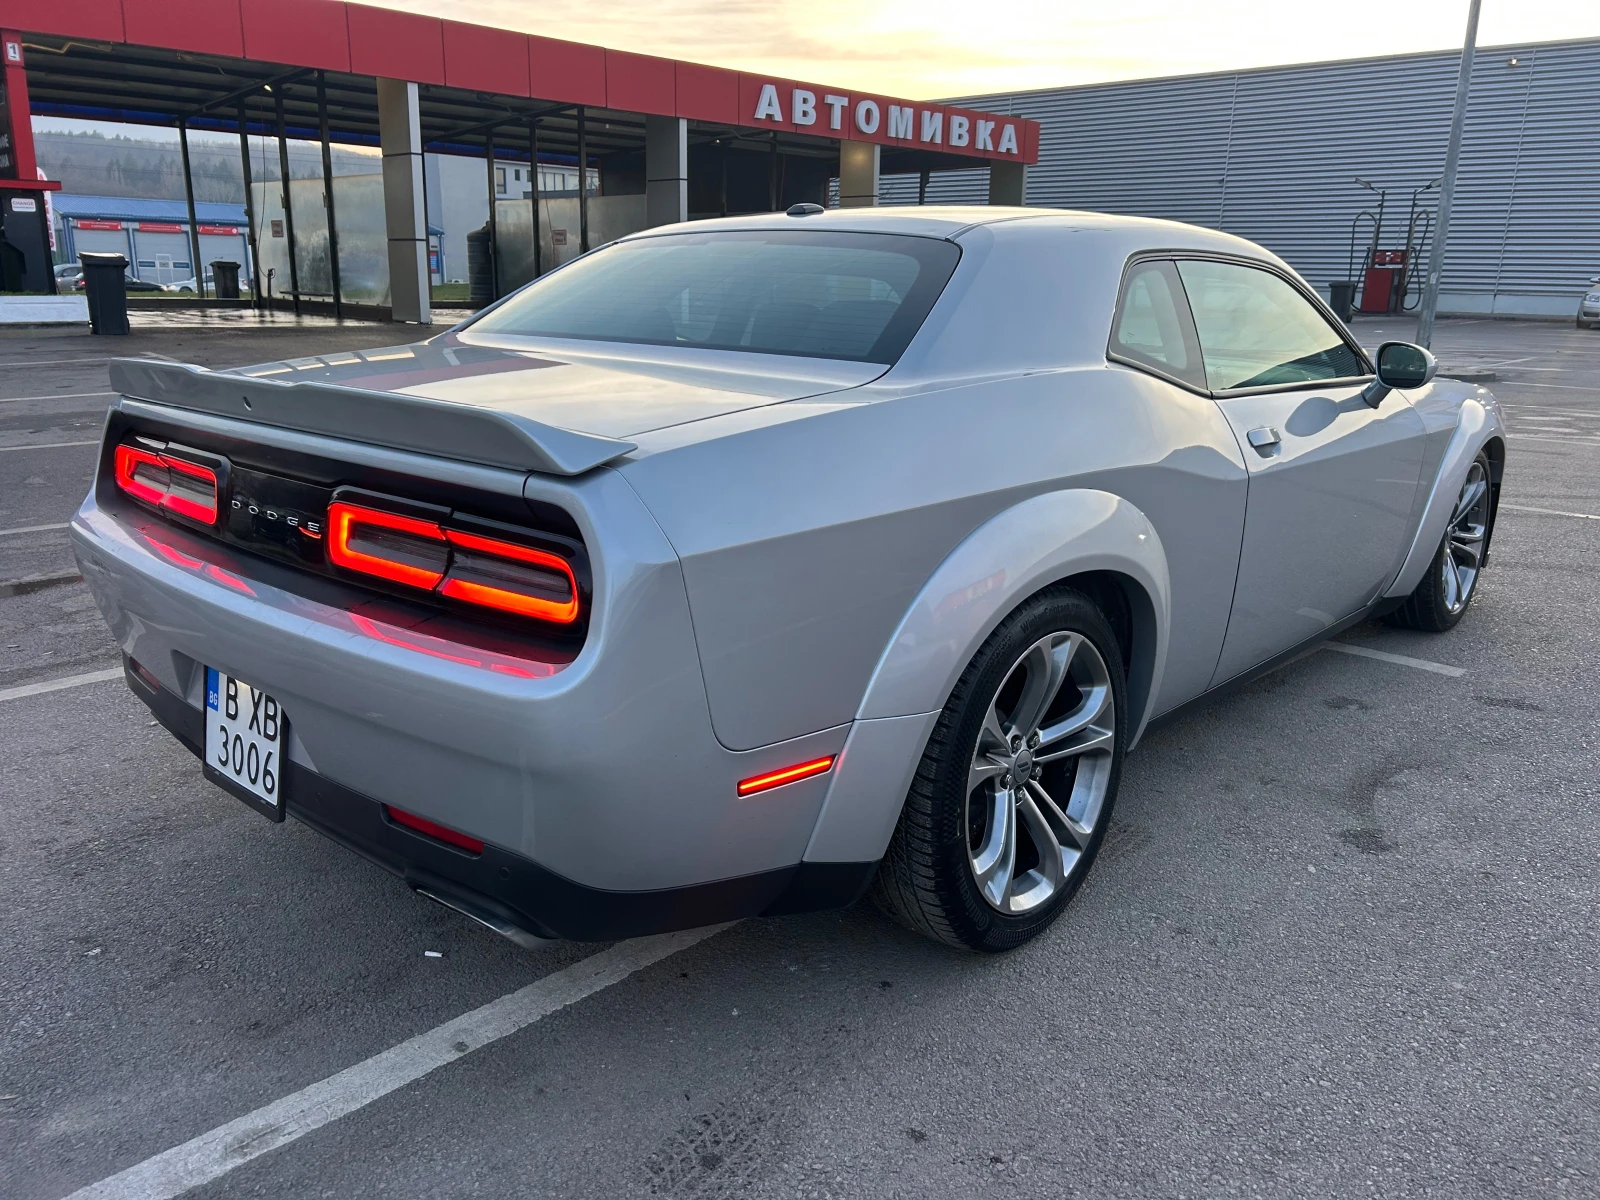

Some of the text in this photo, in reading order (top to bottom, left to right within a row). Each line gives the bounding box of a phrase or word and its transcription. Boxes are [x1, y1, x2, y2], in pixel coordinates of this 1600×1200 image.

[754, 84, 1018, 154] АВТОМИВКА
[231, 500, 320, 532] DODGE
[209, 690, 218, 706] BG
[225, 675, 239, 721] B
[217, 723, 276, 795] 3006
